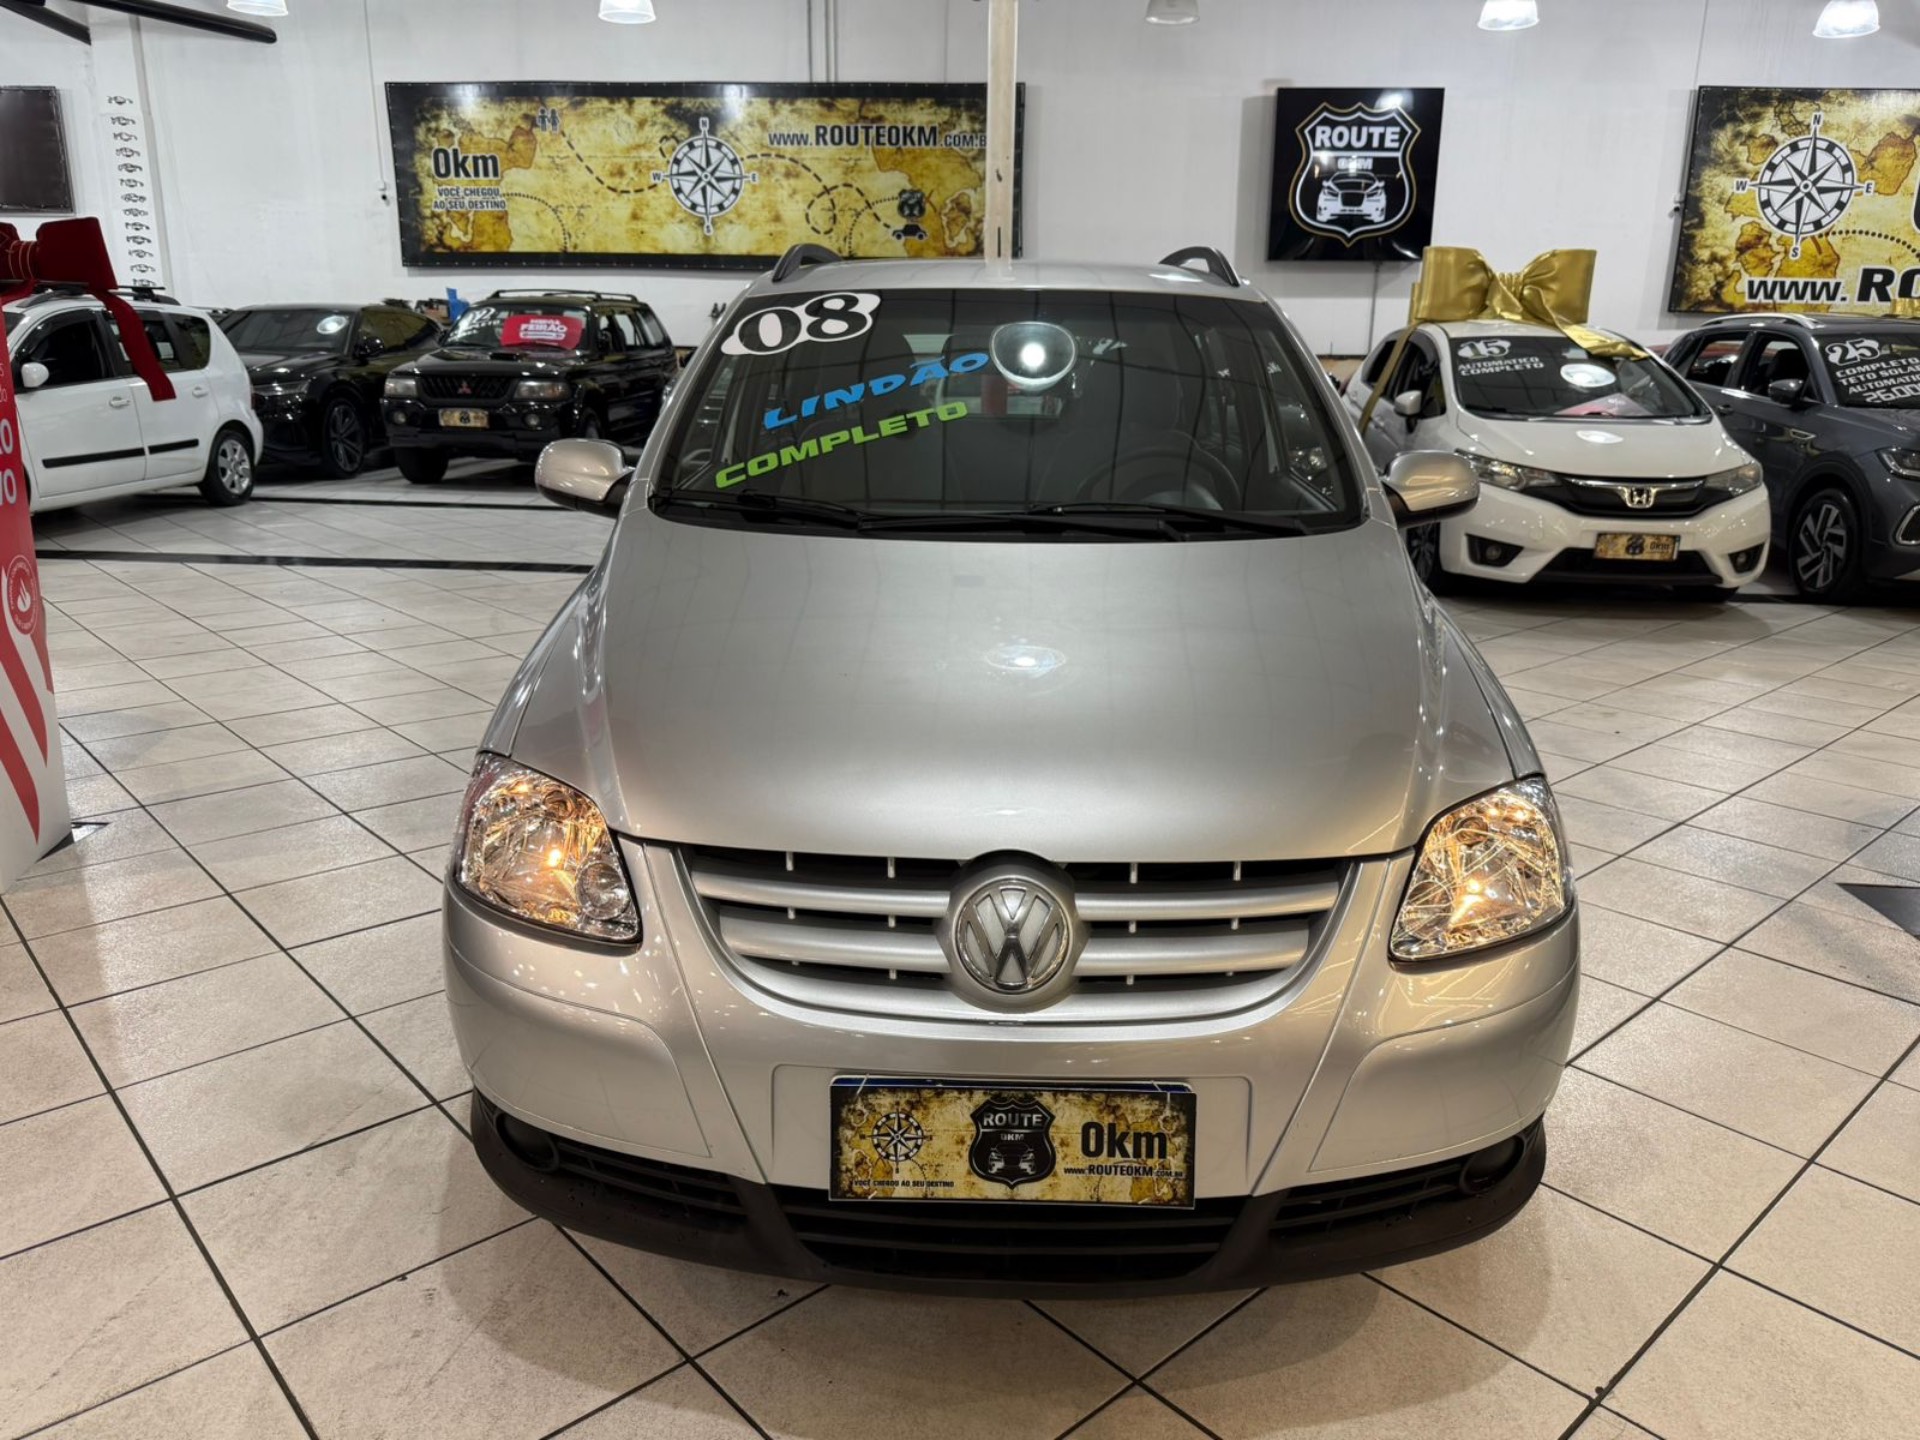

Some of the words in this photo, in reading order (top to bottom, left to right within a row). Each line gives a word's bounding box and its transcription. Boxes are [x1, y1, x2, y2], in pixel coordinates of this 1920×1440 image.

[1812, 113, 1822, 125] N
[1314, 126, 1400, 148] ROUTE
[463, 187, 500, 197] CHEGOU
[1735, 181, 1748, 191] W
[1865, 183, 1873, 193] E
[433, 200, 446, 209] AO
[448, 200, 465, 209] SEU
[468, 200, 506, 209] DESTINO
[1791, 247, 1800, 258] S
[738, 293, 870, 354] 08
[1462, 339, 1510, 359] 15
[1826, 339, 1880, 366] 25
[1460, 363, 1545, 376] COMPLETO
[1836, 357, 1919, 378] COMPLETO
[1839, 372, 1877, 386] TETO
[763, 353, 989, 430] LINDÃO
[715, 401, 968, 488] COMPLETO
[983, 1112, 1043, 1127] ROUTE
[1081, 1121, 1167, 1159] 0km
